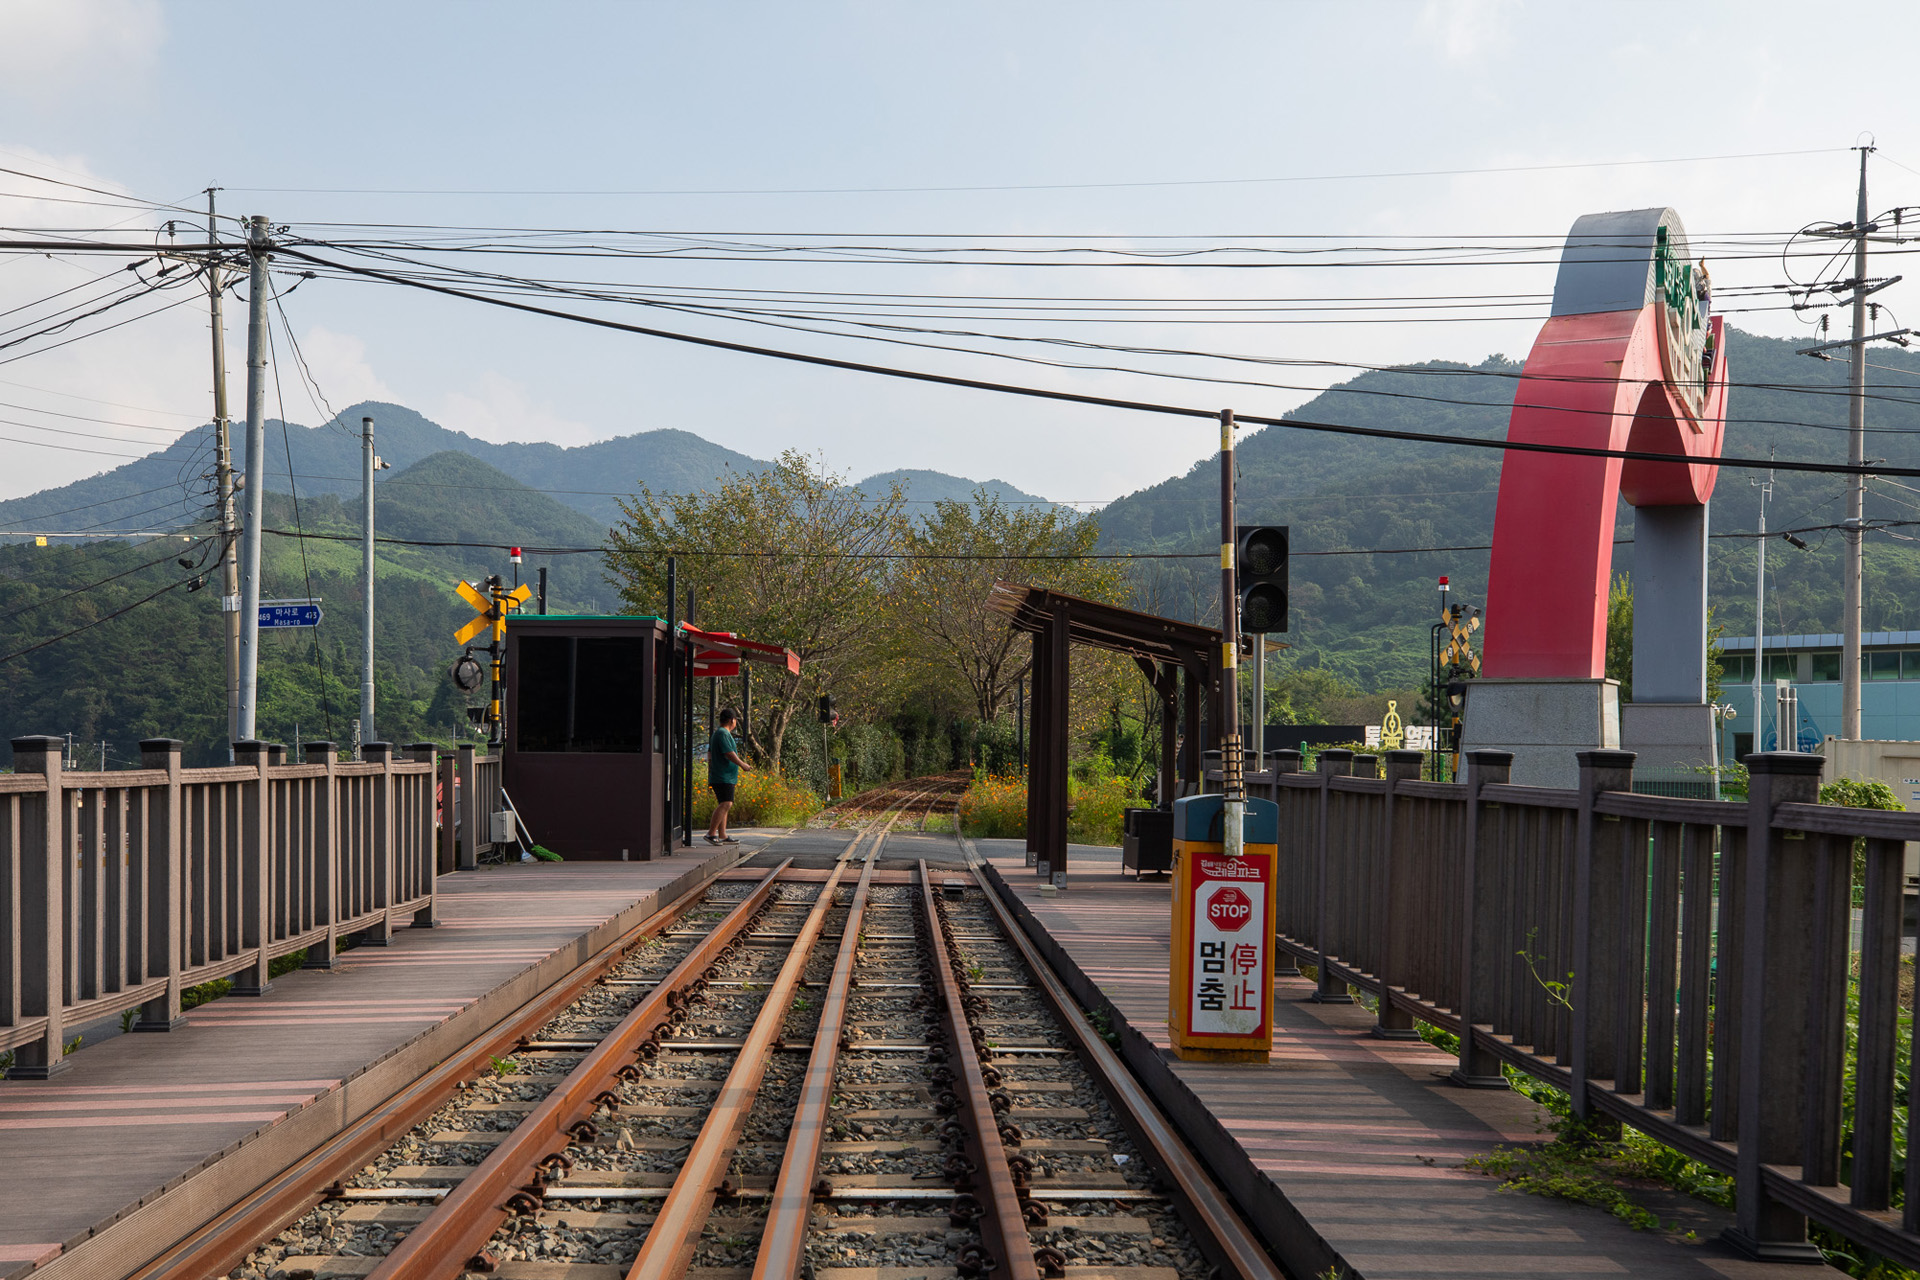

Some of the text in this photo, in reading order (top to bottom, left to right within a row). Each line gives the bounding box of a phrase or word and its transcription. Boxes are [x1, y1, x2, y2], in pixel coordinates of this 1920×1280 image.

[276, 608, 298, 616] 마사로
[1213, 862, 1261, 879] 레일파크
[1210, 903, 1249, 918] STOP
[1197, 941, 1227, 1012] 멈춤
[1229, 943, 1258, 1011] 停止
